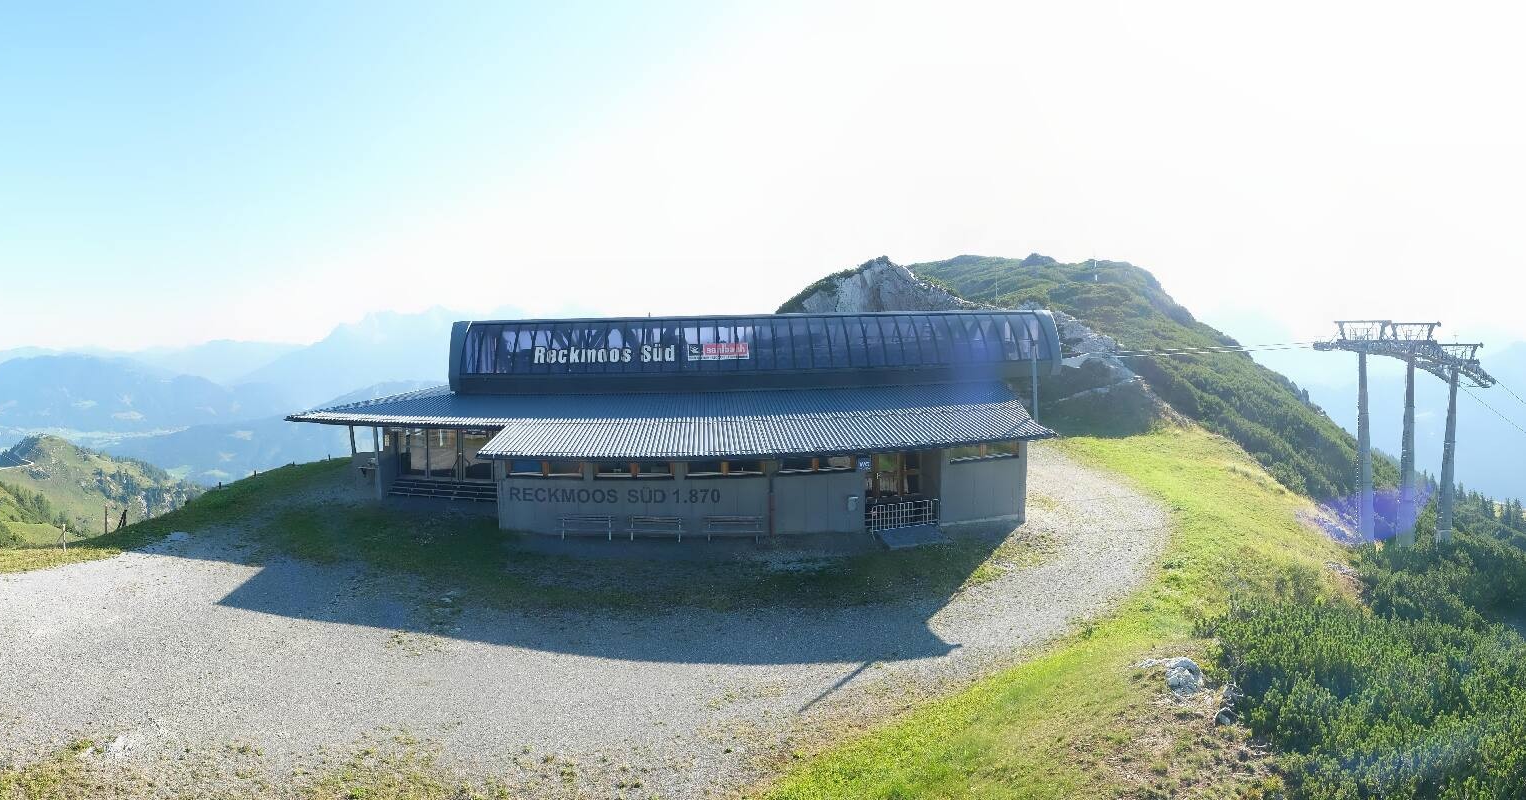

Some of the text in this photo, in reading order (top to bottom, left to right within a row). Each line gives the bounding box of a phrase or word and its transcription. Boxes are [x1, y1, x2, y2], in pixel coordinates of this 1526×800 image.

[533, 343, 675, 364] Reckmoos Süd
[509, 486, 721, 504] RECKMOOS SÜD 1.870
